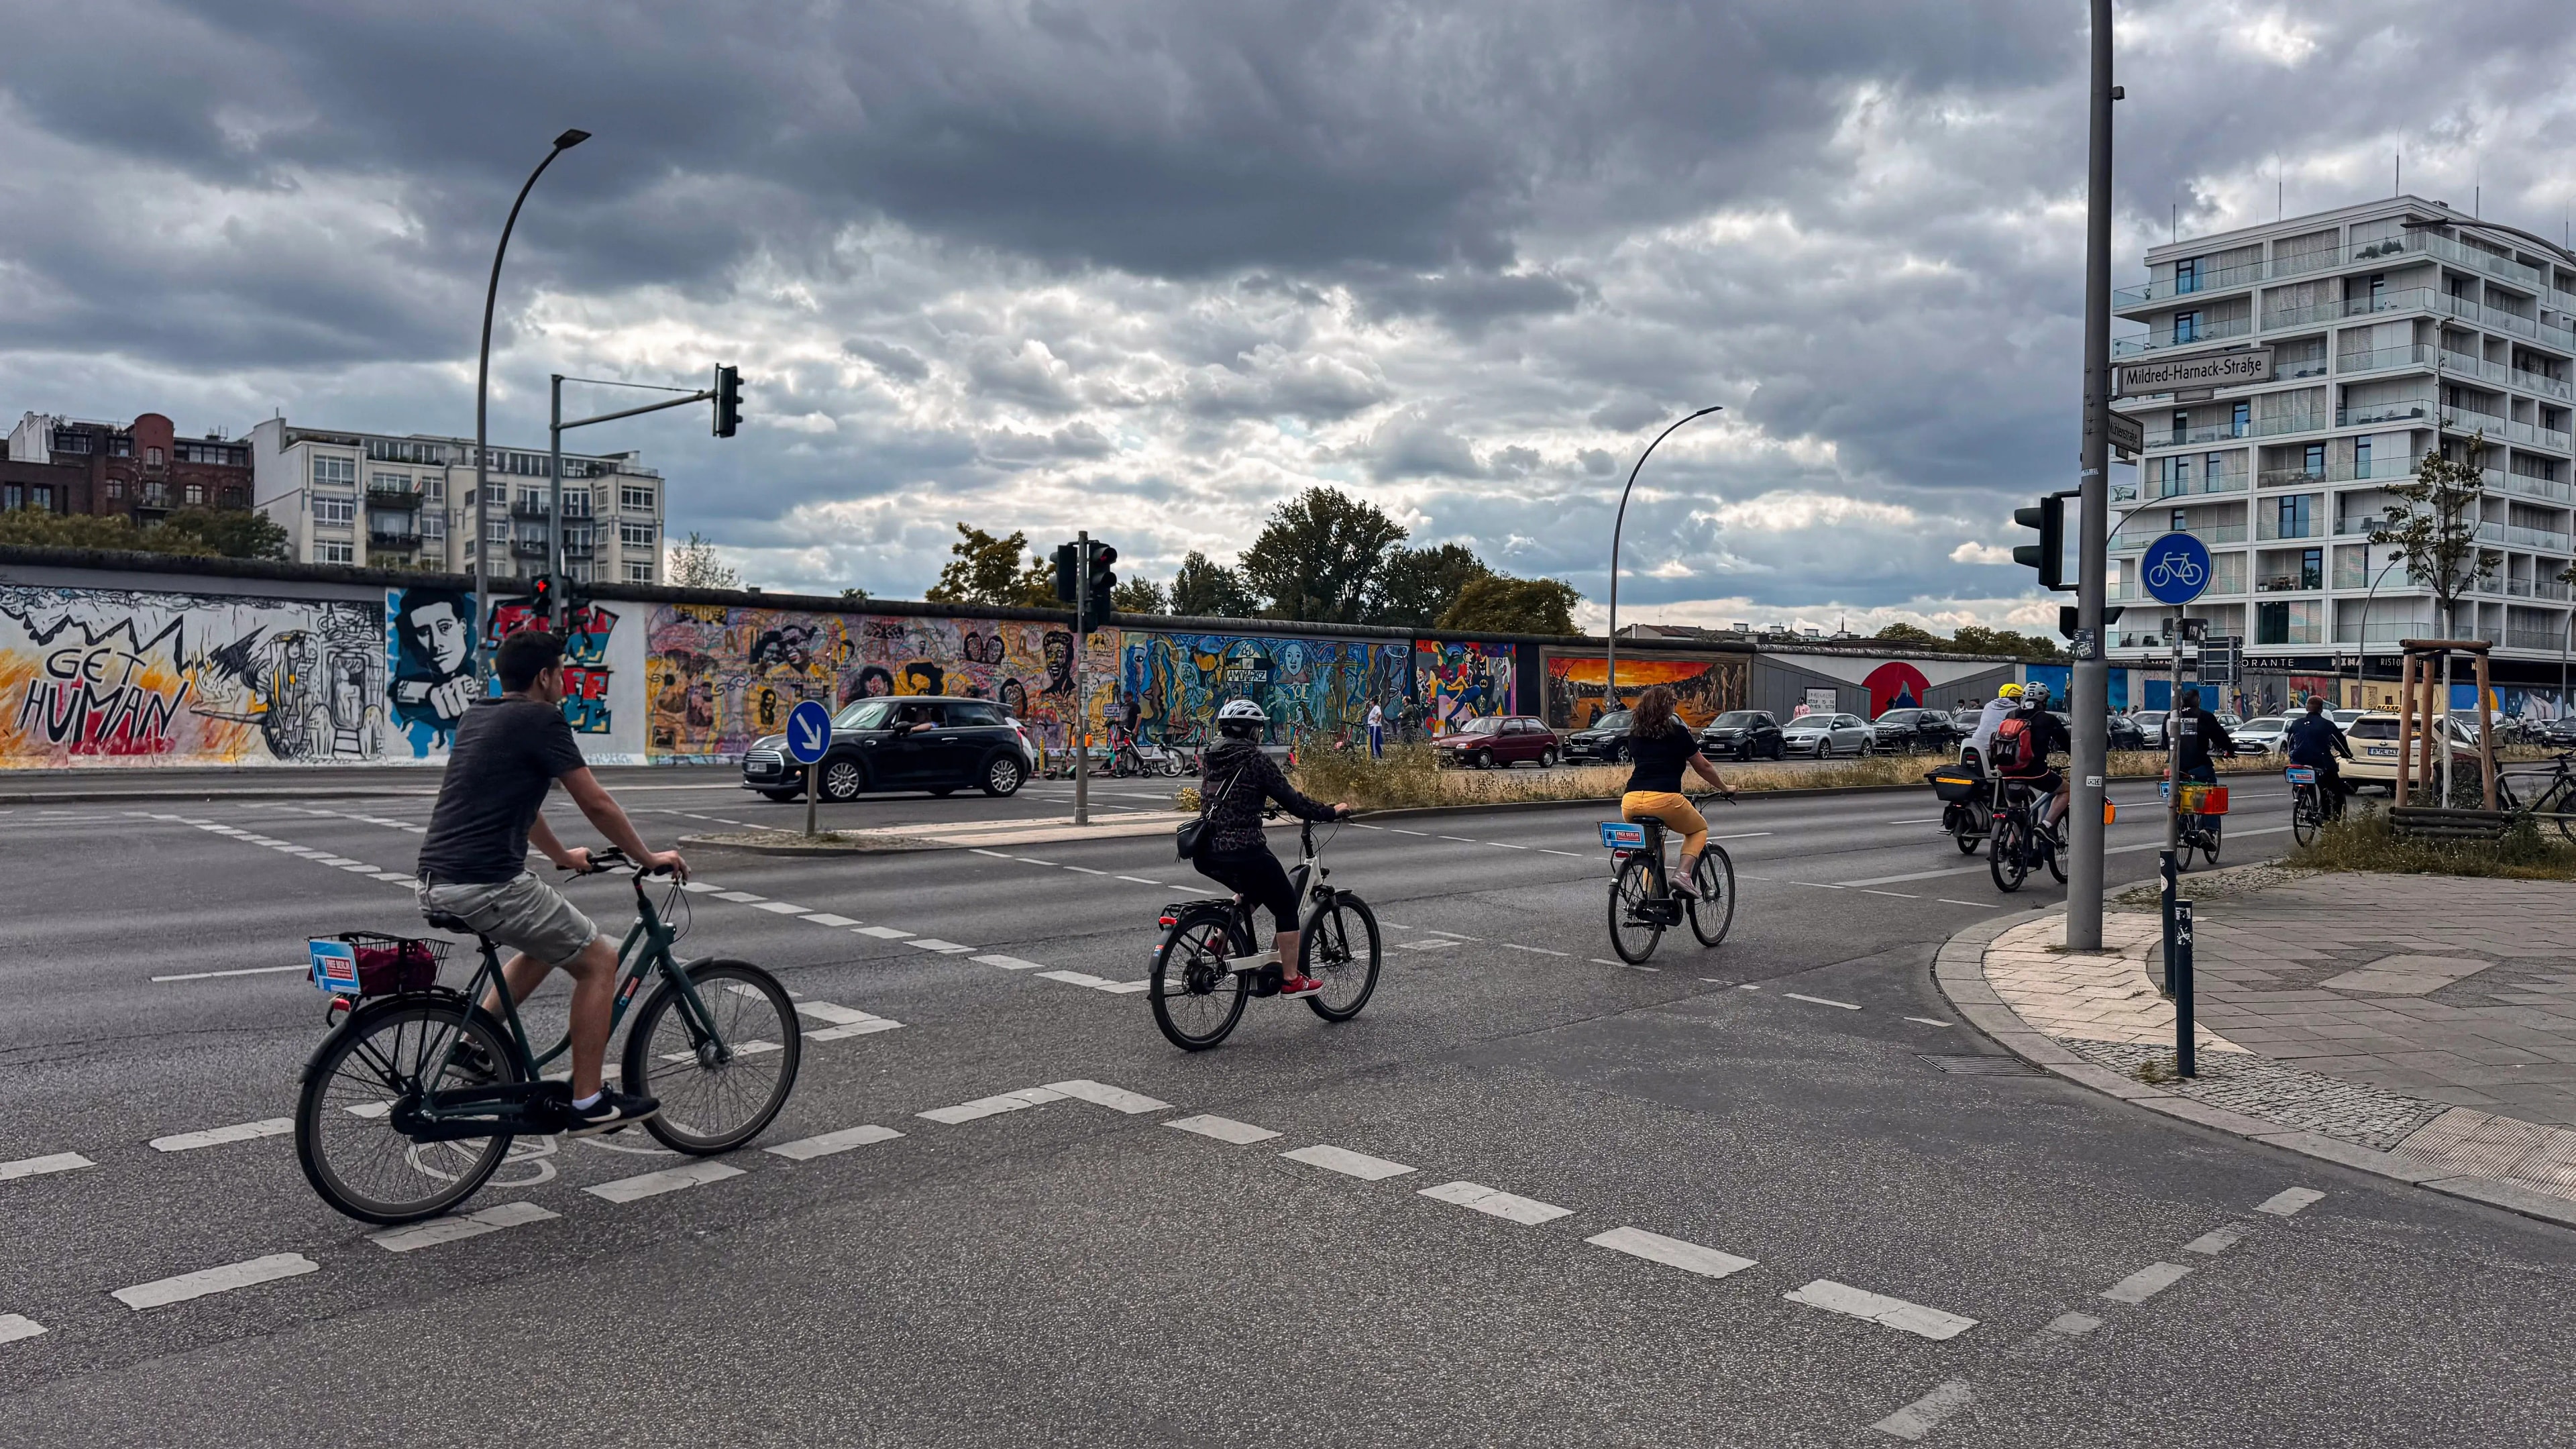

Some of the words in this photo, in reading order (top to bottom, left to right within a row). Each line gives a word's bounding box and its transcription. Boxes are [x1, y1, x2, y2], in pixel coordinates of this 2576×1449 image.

[2127, 356, 2261, 385] Mildred-Harnack-Straße
[46, 648, 146, 686] GET
[2242, 659, 2294, 667] ORANTE
[2381, 658, 2422, 667] RISTOTE
[19, 679, 189, 743] HUMAN
